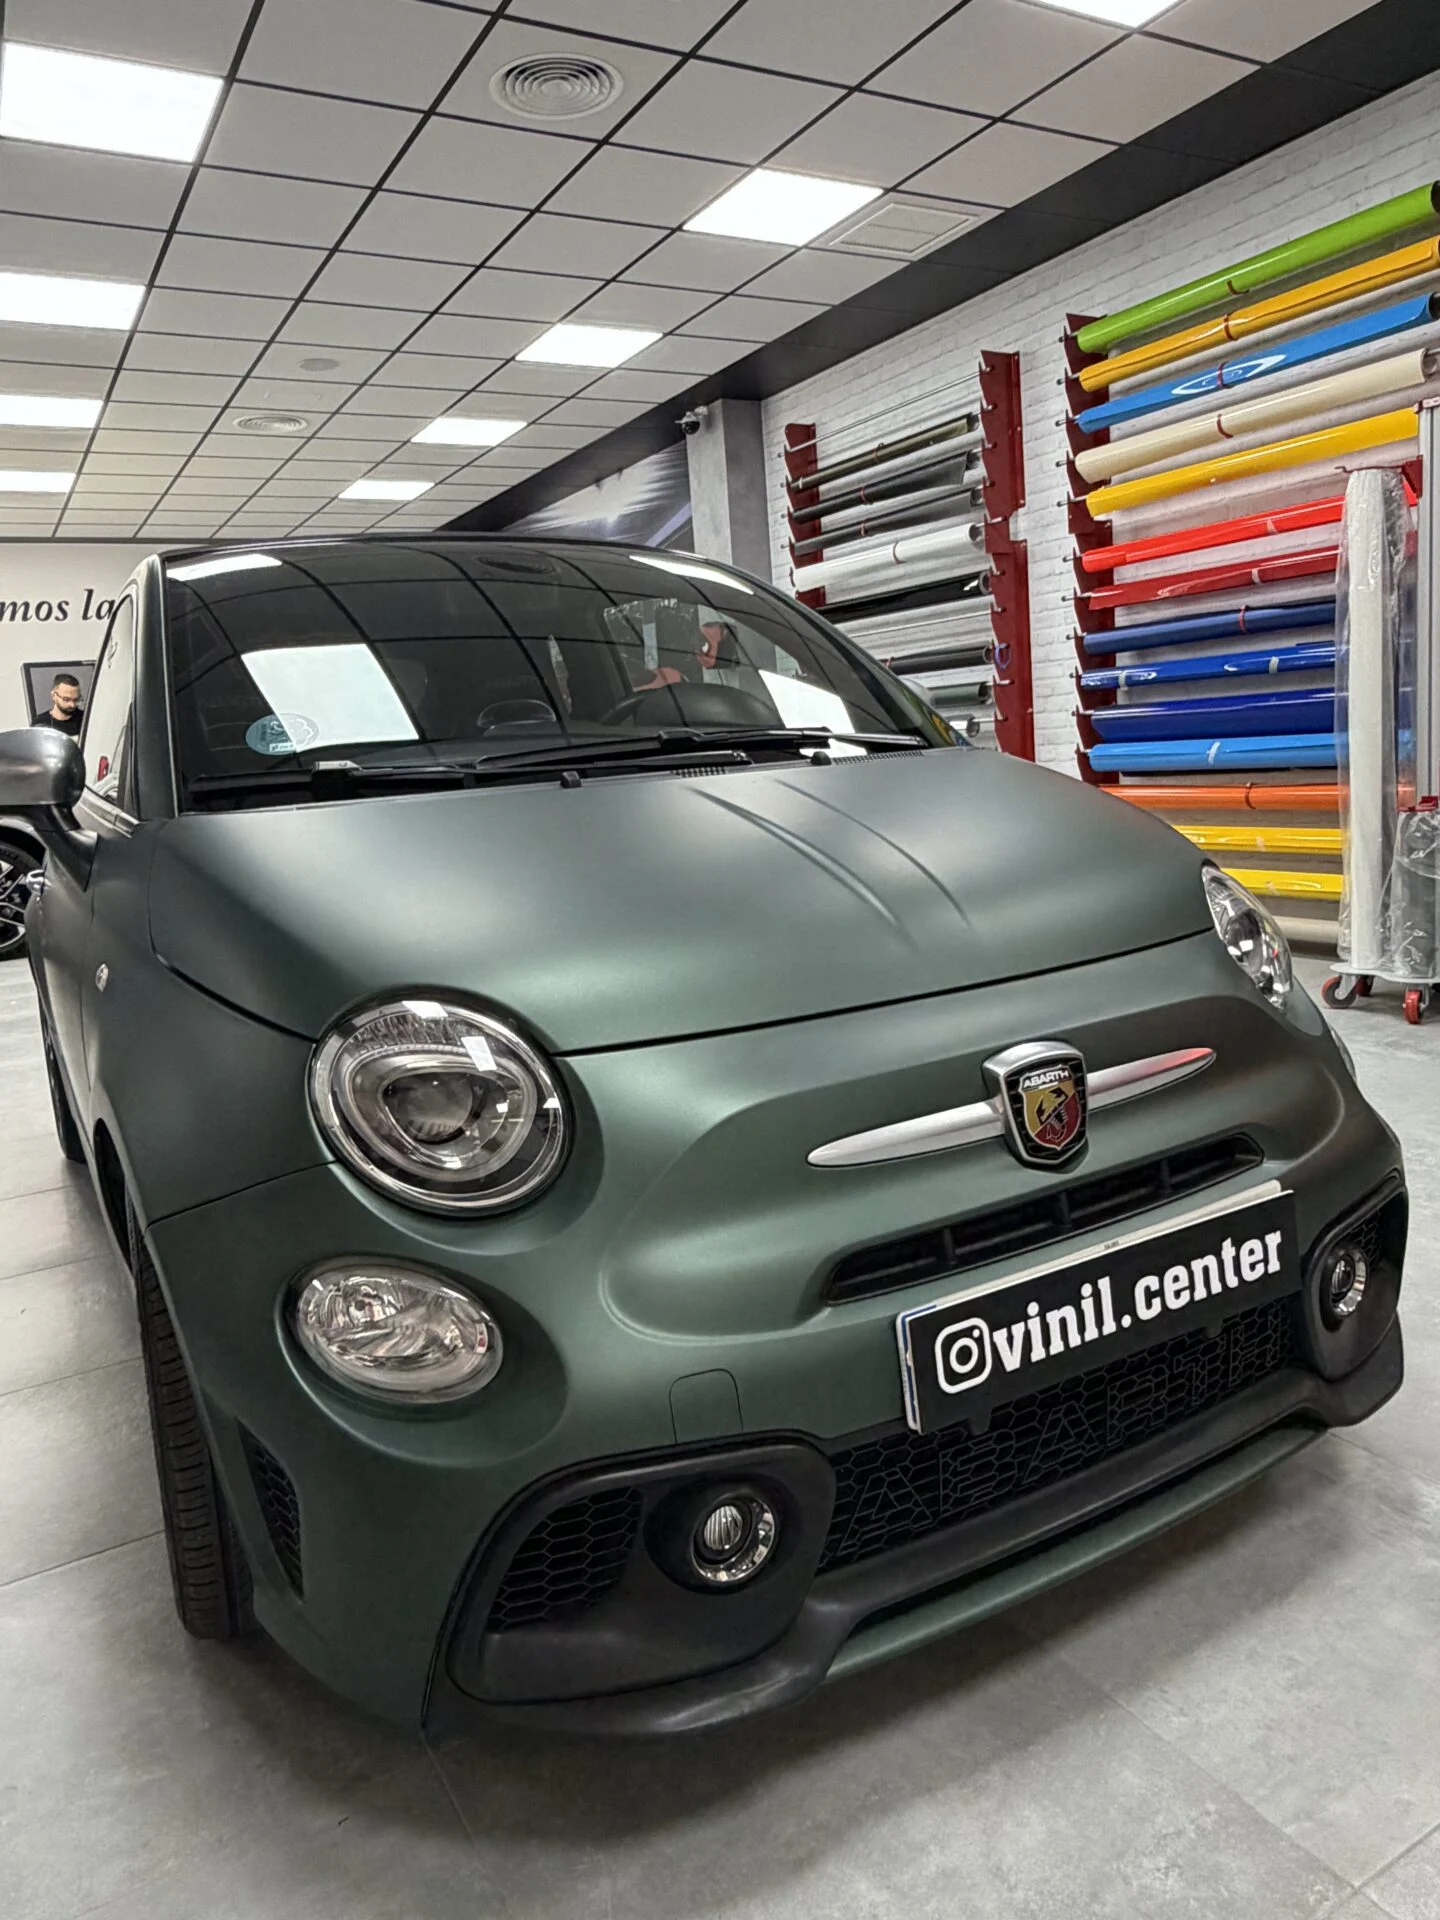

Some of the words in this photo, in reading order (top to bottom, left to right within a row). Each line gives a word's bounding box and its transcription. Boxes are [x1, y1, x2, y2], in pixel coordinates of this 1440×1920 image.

[81, 588, 116, 621] la
[1023, 1069, 1069, 1089] ABARTH
[838, 1305, 1284, 1556] ABARTH
